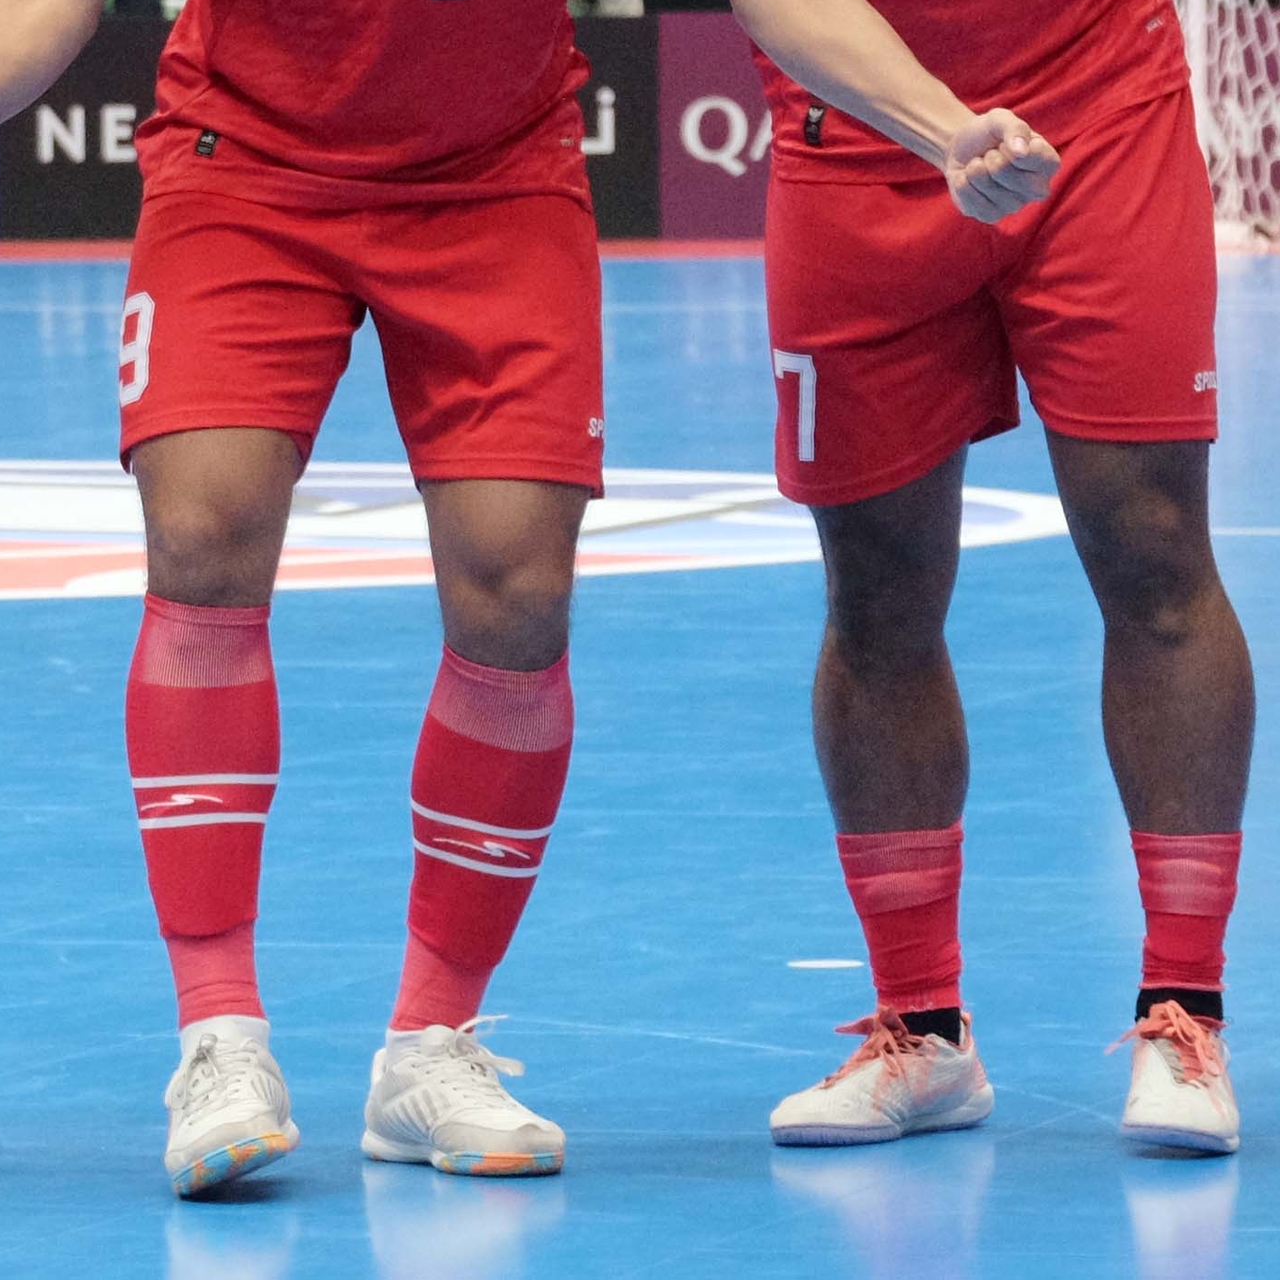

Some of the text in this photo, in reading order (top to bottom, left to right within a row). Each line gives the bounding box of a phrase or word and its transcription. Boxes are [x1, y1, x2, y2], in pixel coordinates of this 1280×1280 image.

[36, 102, 139, 165] NE
[119, 291, 155, 407] 9
[772, 349, 818, 463] 7
